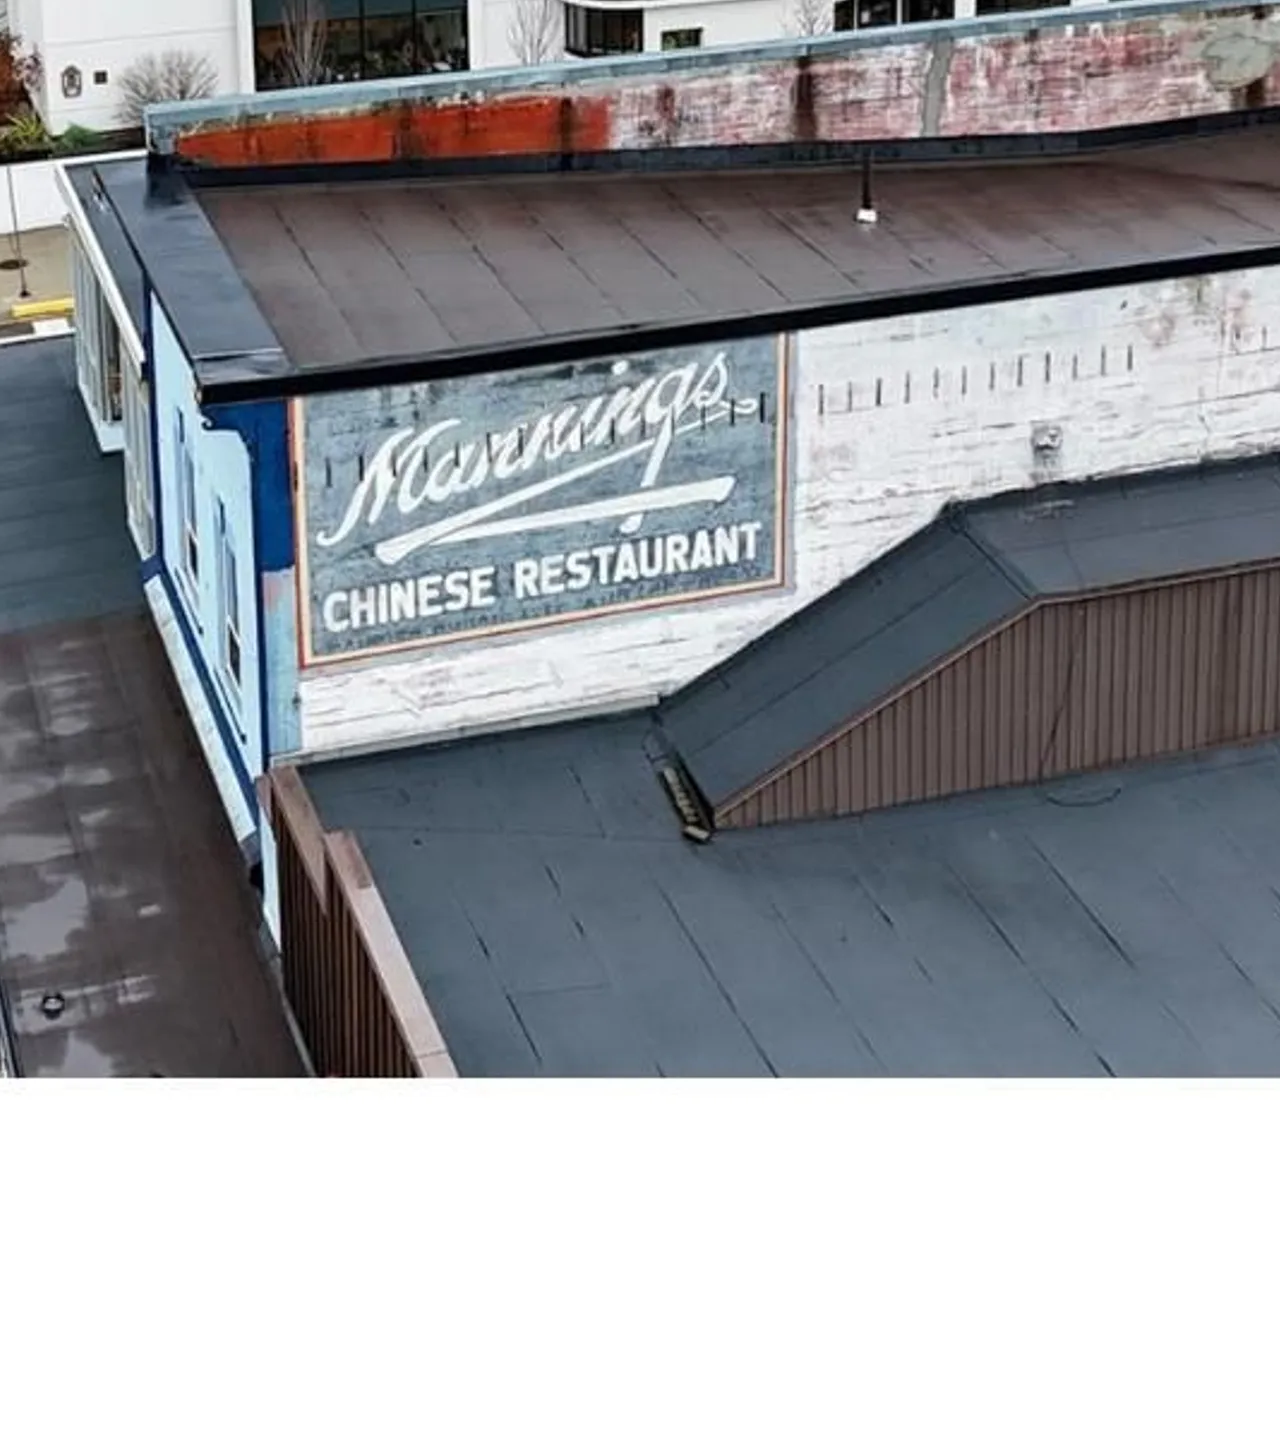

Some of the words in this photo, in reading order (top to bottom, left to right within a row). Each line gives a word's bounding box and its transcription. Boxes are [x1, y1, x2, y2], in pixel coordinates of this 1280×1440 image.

[317, 353, 757, 544] Mannings
[323, 567, 495, 632] CHINESE
[516, 522, 760, 598] RESTAURANT
